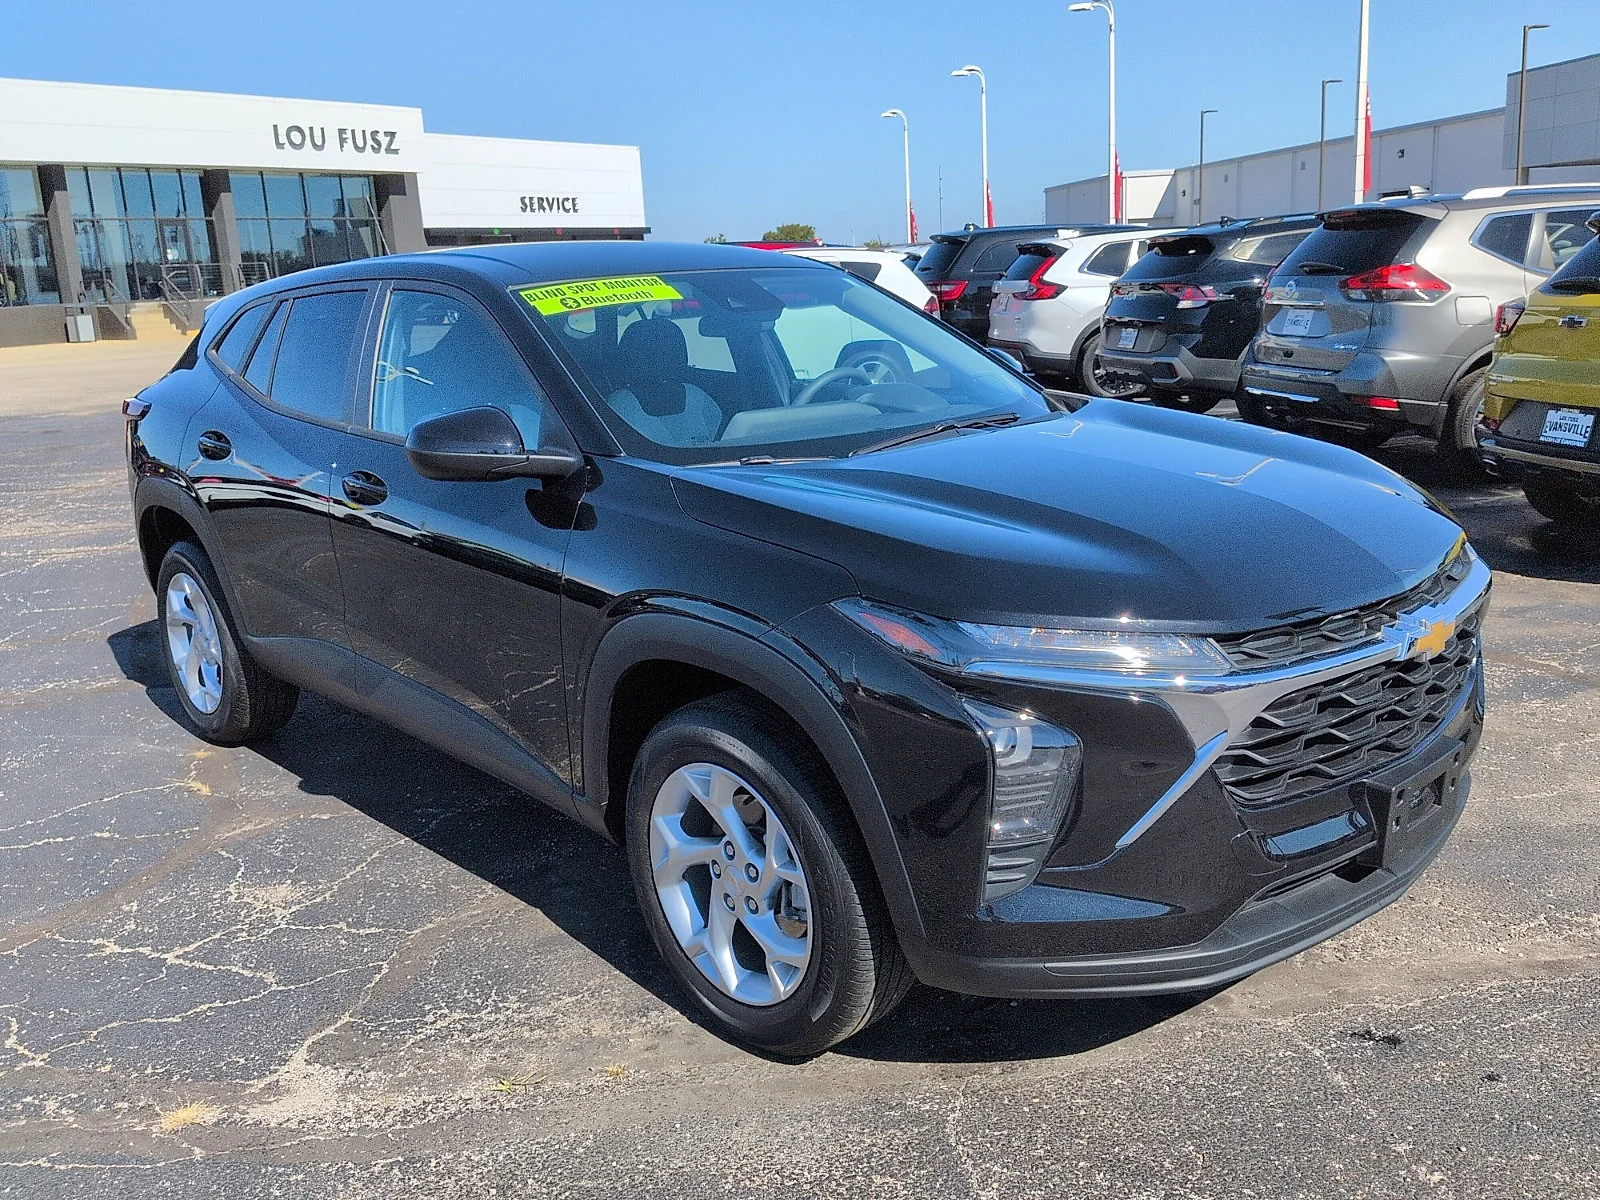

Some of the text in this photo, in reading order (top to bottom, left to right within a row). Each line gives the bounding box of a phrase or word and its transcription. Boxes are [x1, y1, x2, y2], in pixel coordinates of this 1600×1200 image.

[273, 124, 400, 155] LOU FUSZ
[520, 196, 579, 214] SERVICE
[524, 277, 663, 303] BLIND SPOT MONITOR
[581, 290, 654, 306] Bluetooth
[1543, 420, 1591, 439] EVANSVILLE
